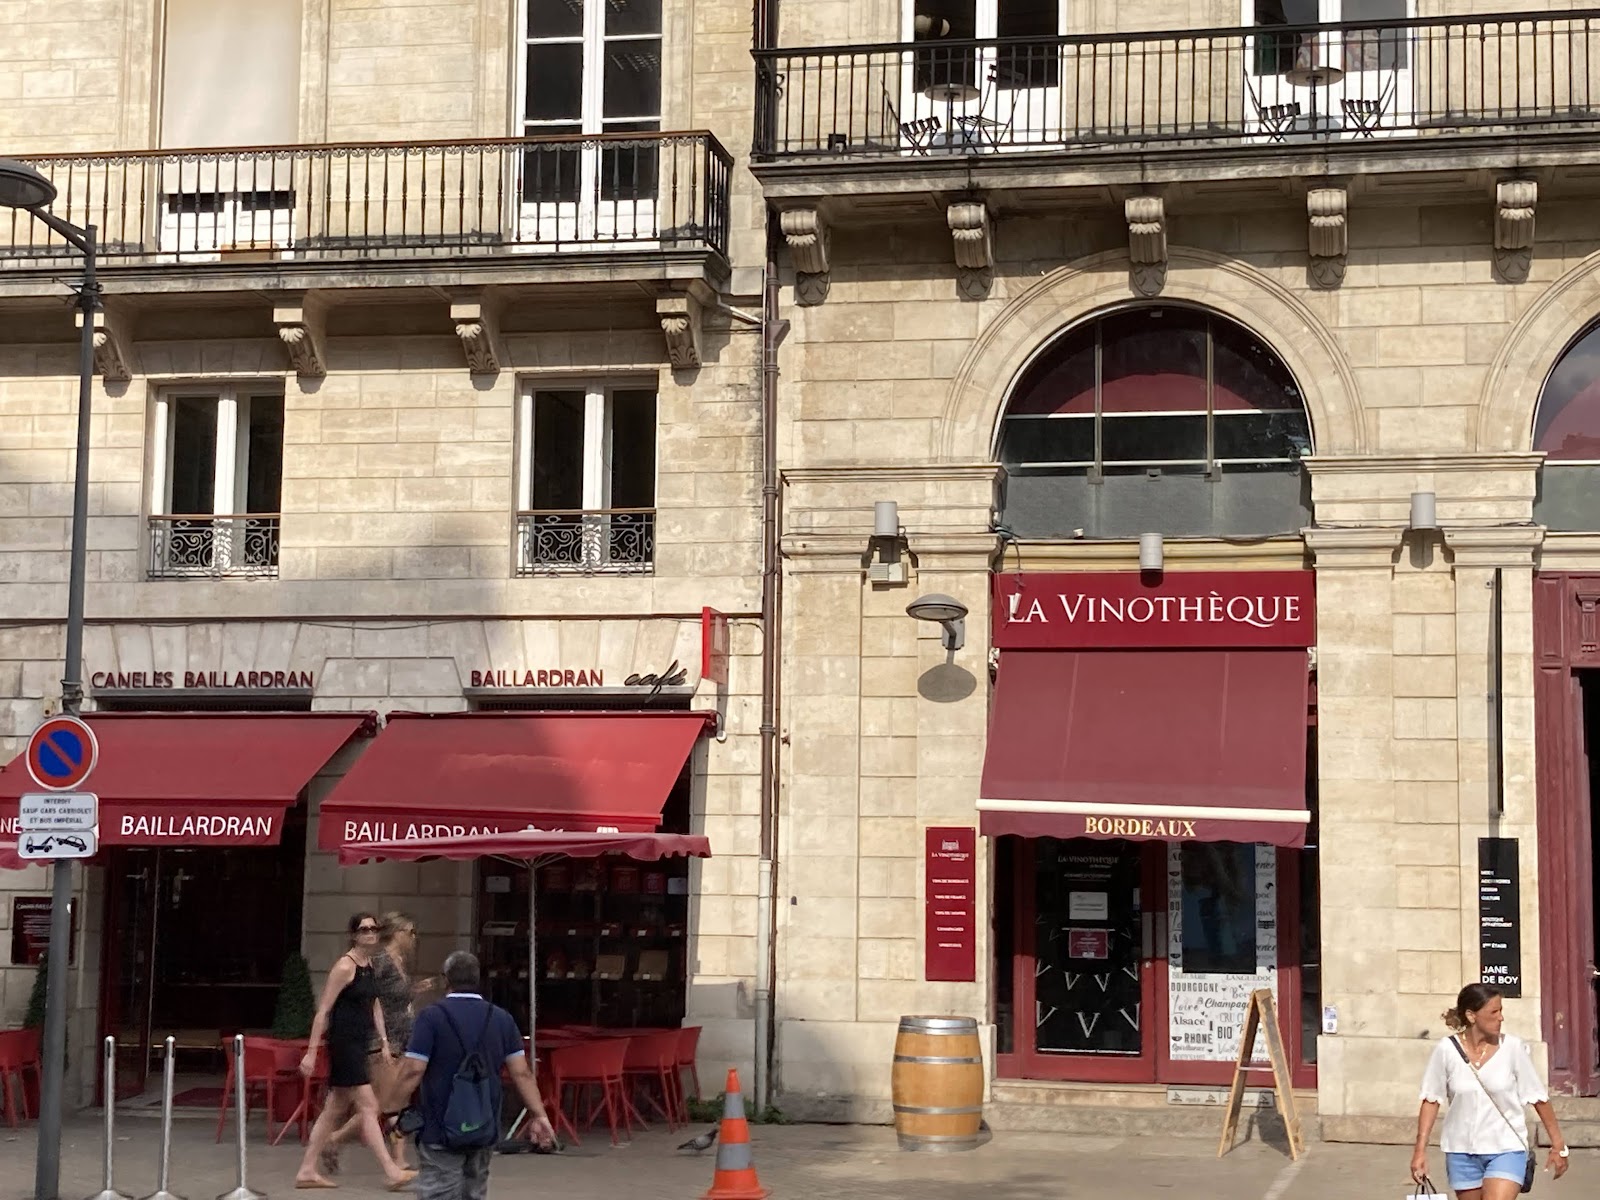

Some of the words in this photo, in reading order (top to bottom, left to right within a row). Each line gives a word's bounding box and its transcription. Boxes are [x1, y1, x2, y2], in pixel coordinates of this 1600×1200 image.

[1007, 594, 1049, 623] LA
[1057, 590, 1301, 628] VINOTHÈQUE
[184, 671, 313, 688] BAILLARDRAN
[471, 669, 603, 687] BAILLARDRAN
[624, 659, 688, 702] café
[120, 816, 272, 836] BAILLARDRAN
[1085, 816, 1196, 837] BORDEAUX
[1482, 966, 1508, 974] JANE
[1482, 976, 1495, 984] DE
[1498, 976, 1518, 984] BOY
[1171, 982, 1219, 993] BOURGOGNE
[1204, 997, 1250, 1011] Champag
[1172, 1016, 1205, 1026] Alsace
[1217, 1026, 1233, 1039] BIO
